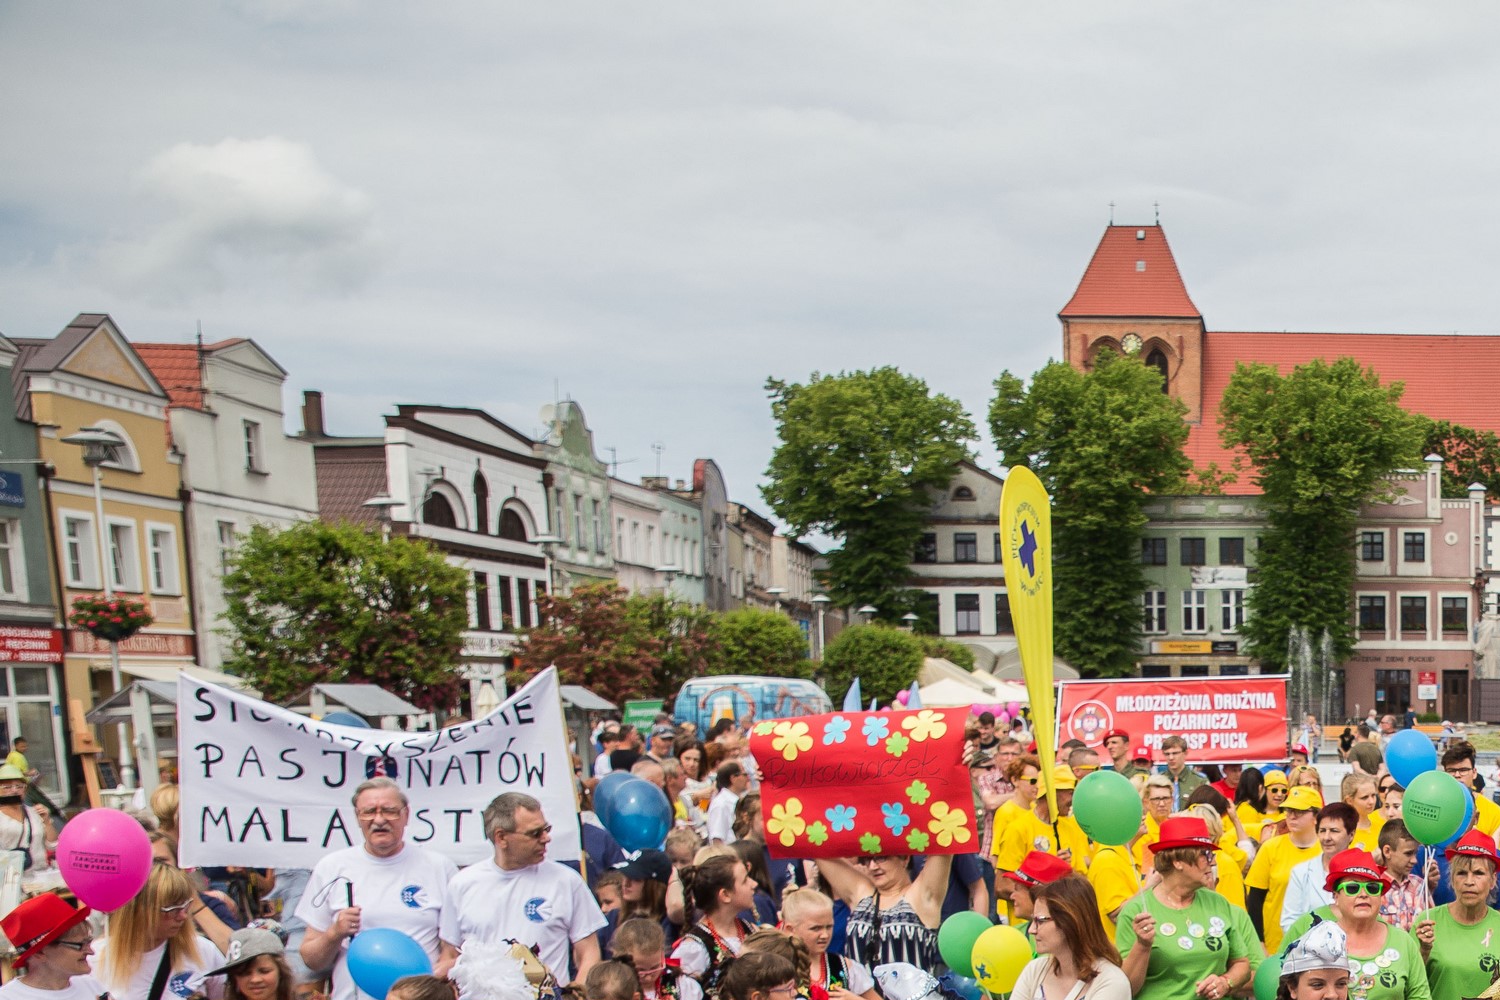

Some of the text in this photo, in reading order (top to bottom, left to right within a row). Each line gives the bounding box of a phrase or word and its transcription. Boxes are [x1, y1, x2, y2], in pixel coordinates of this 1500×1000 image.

[1115, 690, 1277, 712] MŁODZIEŻOWA DRUŻYNA
[1153, 711, 1238, 731] POŻARNICZA
[1210, 732, 1249, 749] PUCK
